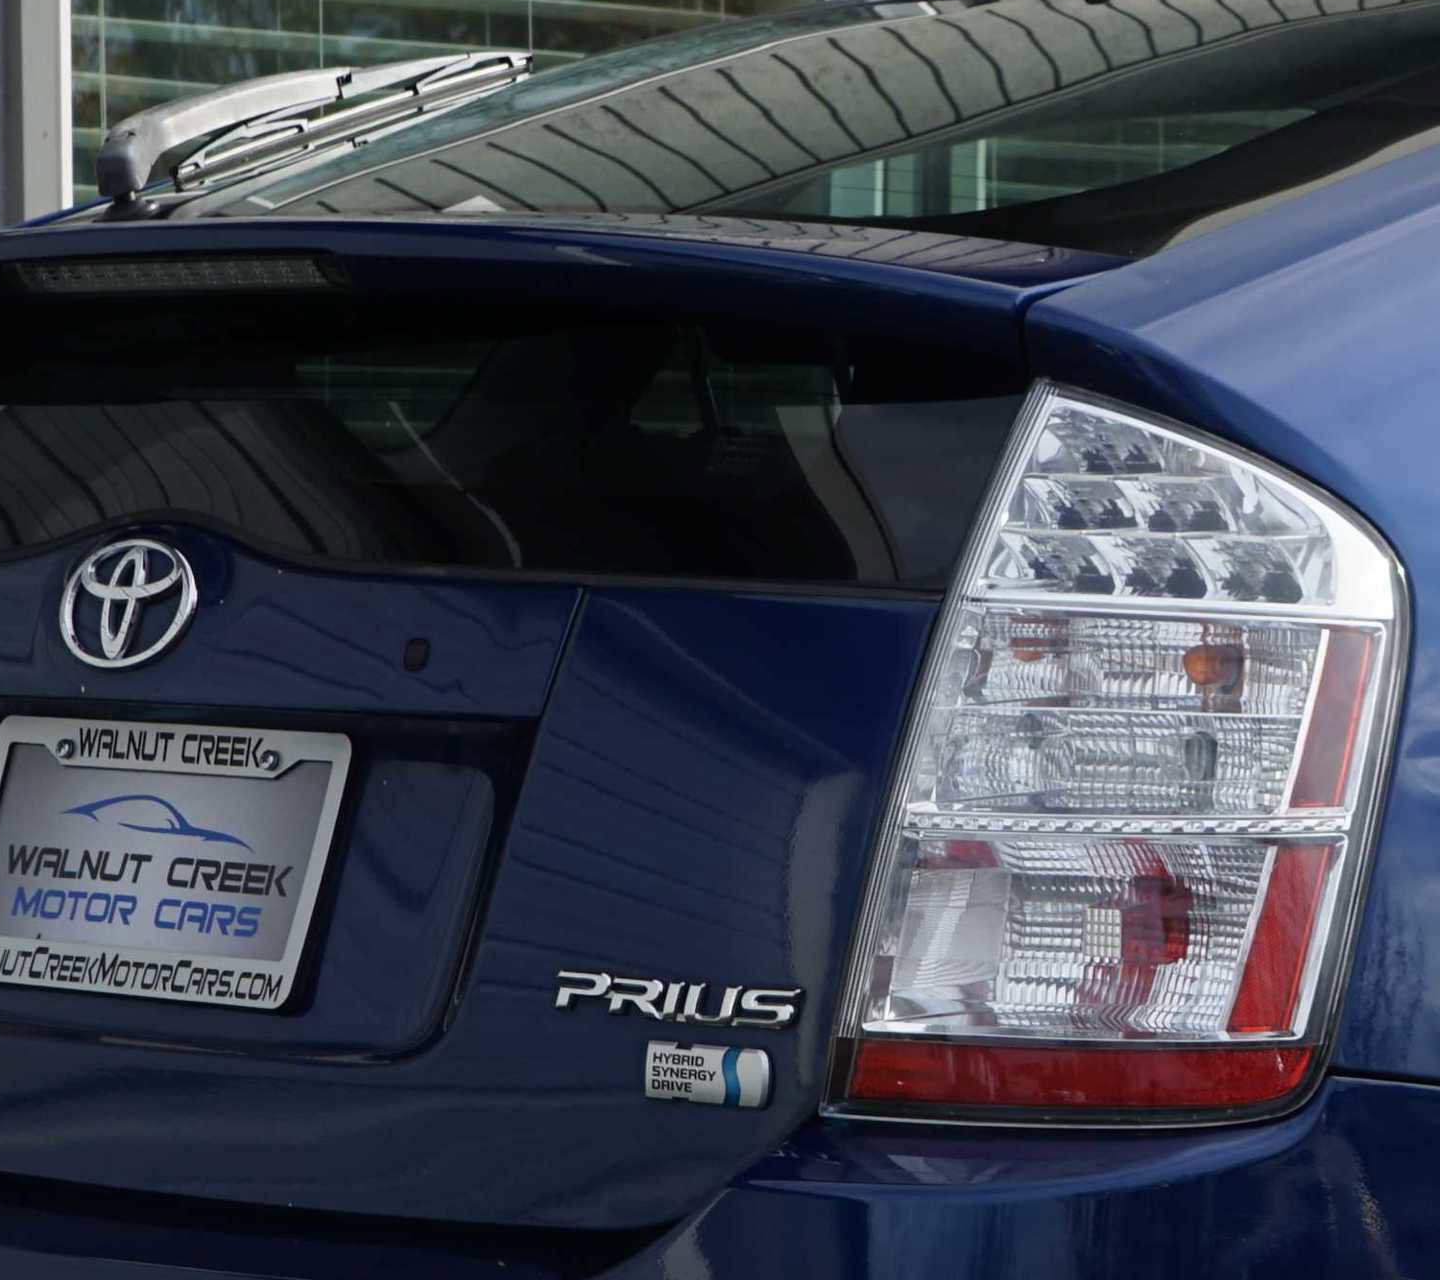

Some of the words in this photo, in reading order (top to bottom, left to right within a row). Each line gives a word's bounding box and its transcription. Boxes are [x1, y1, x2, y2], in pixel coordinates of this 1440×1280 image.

[79, 727, 174, 762] WALNUT
[181, 733, 264, 768] CREEK
[8, 845, 152, 884] WALNUT
[167, 858, 293, 897] CREEK
[11, 887, 137, 926] MOTOR
[155, 899, 262, 938] CARS
[555, 970, 804, 1029] PRIUS
[651, 1066, 716, 1082] SYNERGY
[652, 1052, 705, 1068] HYBRID
[651, 1079, 693, 1093] DRIVE
